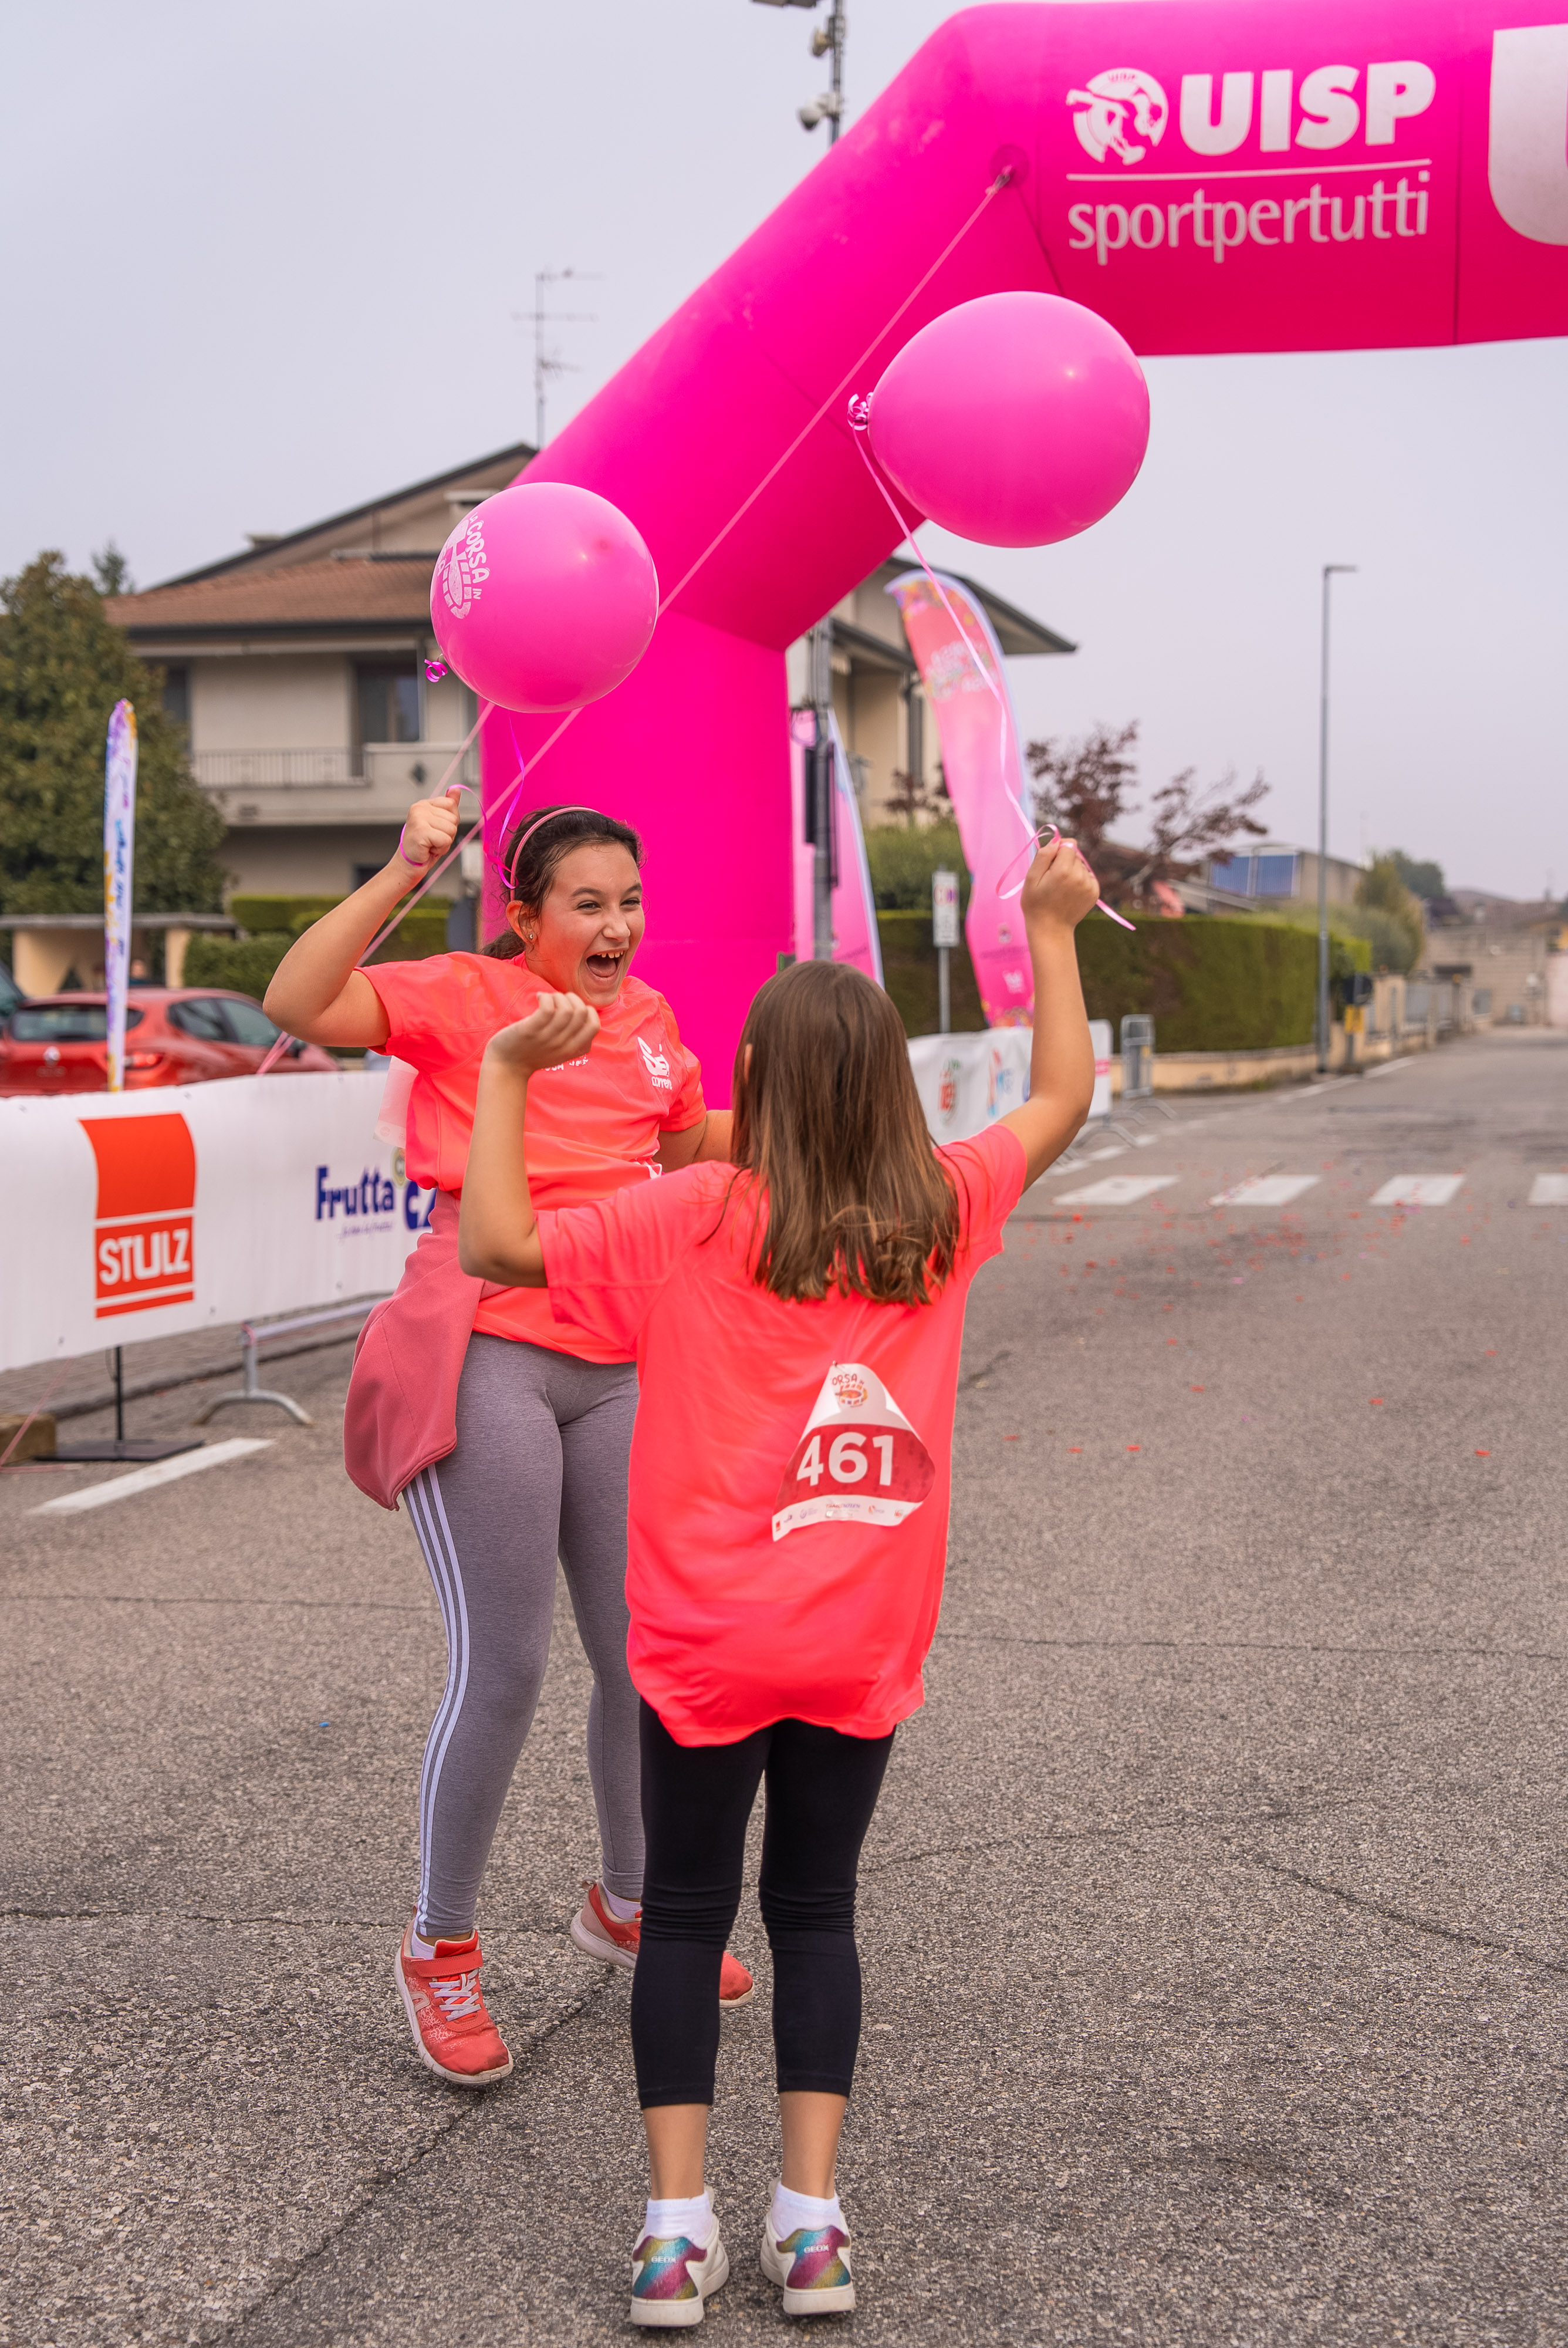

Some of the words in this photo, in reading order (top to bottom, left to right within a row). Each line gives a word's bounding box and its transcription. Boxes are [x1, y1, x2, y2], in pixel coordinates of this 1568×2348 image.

[1180, 60, 1437, 156] UISP
[1067, 170, 1430, 266] sportpertutti
[465, 520, 490, 583] CORSA
[472, 588, 482, 600] IN
[316, 1165, 395, 1221] Frutta
[99, 1227, 191, 1286] STULZ
[832, 1374, 857, 1385] ORSA
[796, 1432, 894, 1486] 461
[651, 2255, 677, 2264] GEOX
[803, 2244, 829, 2254] GEOX
